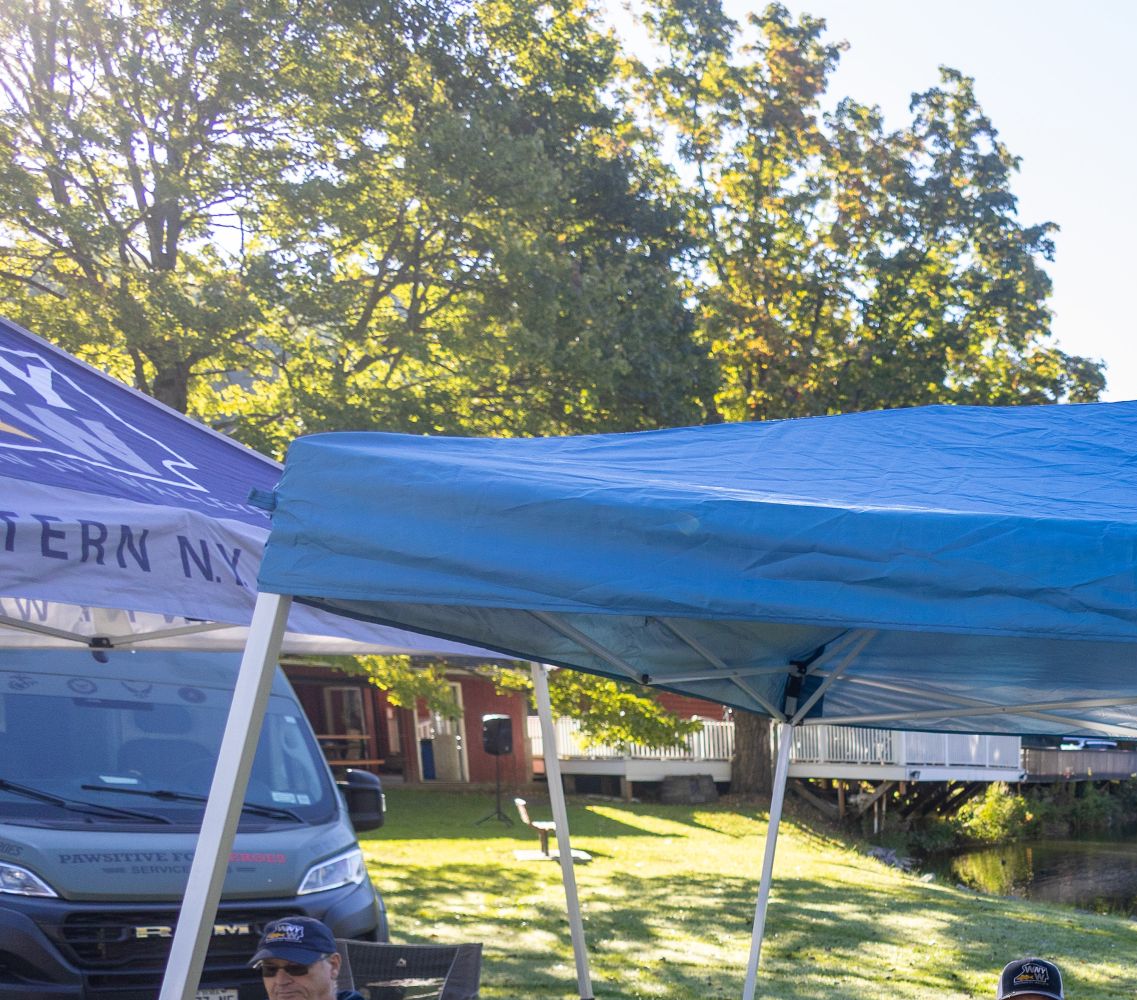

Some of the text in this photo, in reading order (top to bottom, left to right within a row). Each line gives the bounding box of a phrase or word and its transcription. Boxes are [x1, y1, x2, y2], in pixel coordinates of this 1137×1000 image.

[176, 534, 248, 587] N.Y.
[59, 852, 169, 864] PAWSITIVE
[136, 924, 249, 938] RM
